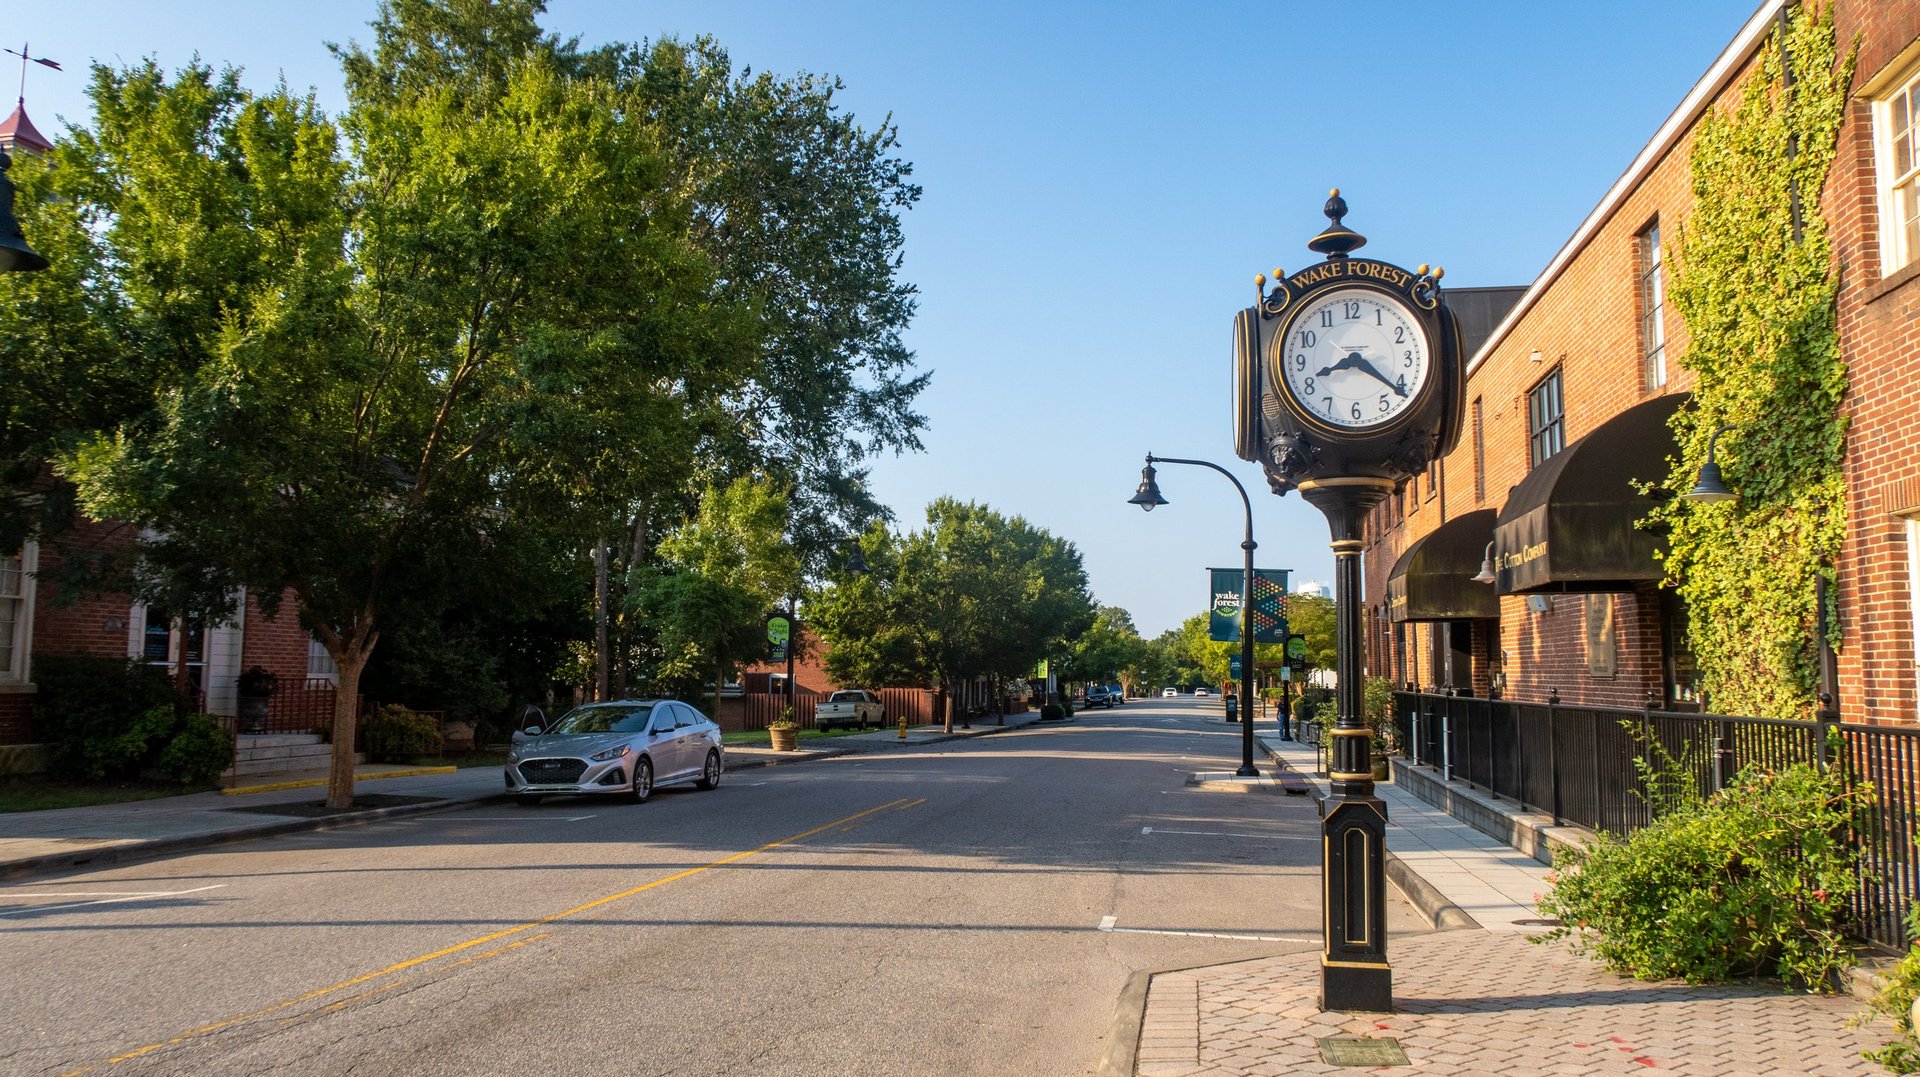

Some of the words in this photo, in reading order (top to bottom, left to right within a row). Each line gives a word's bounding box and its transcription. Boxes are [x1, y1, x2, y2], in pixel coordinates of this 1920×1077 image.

[1291, 262, 1343, 289] WAKE
[1346, 261, 1412, 288] FOREST
[1320, 310, 1334, 328] 11
[1343, 302, 1361, 320] 12
[1375, 308, 1383, 326] 1
[1300, 330, 1316, 348] 10
[1394, 326, 1406, 344] 2
[1296, 354, 1306, 372] 9
[1404, 350, 1412, 368] 3
[1304, 376, 1315, 396] 8
[1396, 374, 1407, 392] 4
[1321, 396, 1332, 416] 7
[1352, 402, 1362, 420] 6
[1378, 393, 1390, 412] 5
[1212, 598, 1240, 610] forest
[1215, 590, 1240, 600] wake
